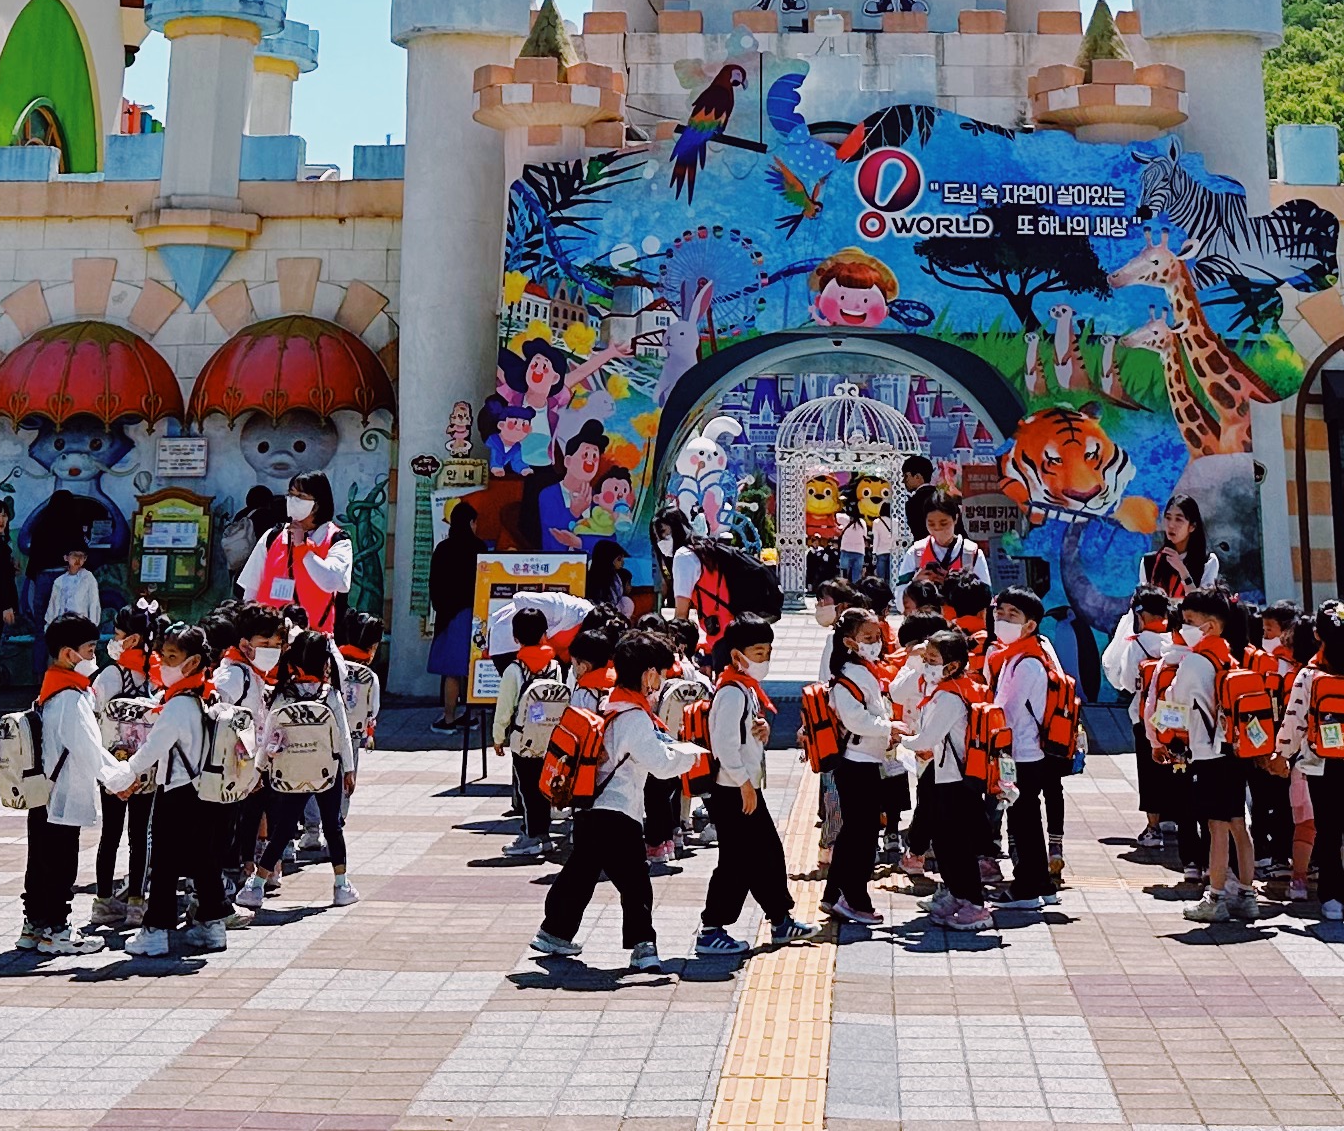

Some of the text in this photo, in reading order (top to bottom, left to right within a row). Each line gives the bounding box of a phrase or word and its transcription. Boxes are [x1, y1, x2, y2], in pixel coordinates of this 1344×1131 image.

[981, 184, 998, 204] 속
[1002, 184, 1053, 205] 자연이
[1057, 185, 1125, 206] 살아있는
[891, 216, 992, 234] WORLD
[1016, 215, 1034, 234] 또
[1038, 215, 1089, 235] 하나의
[965, 505, 1019, 519] 방역패키지
